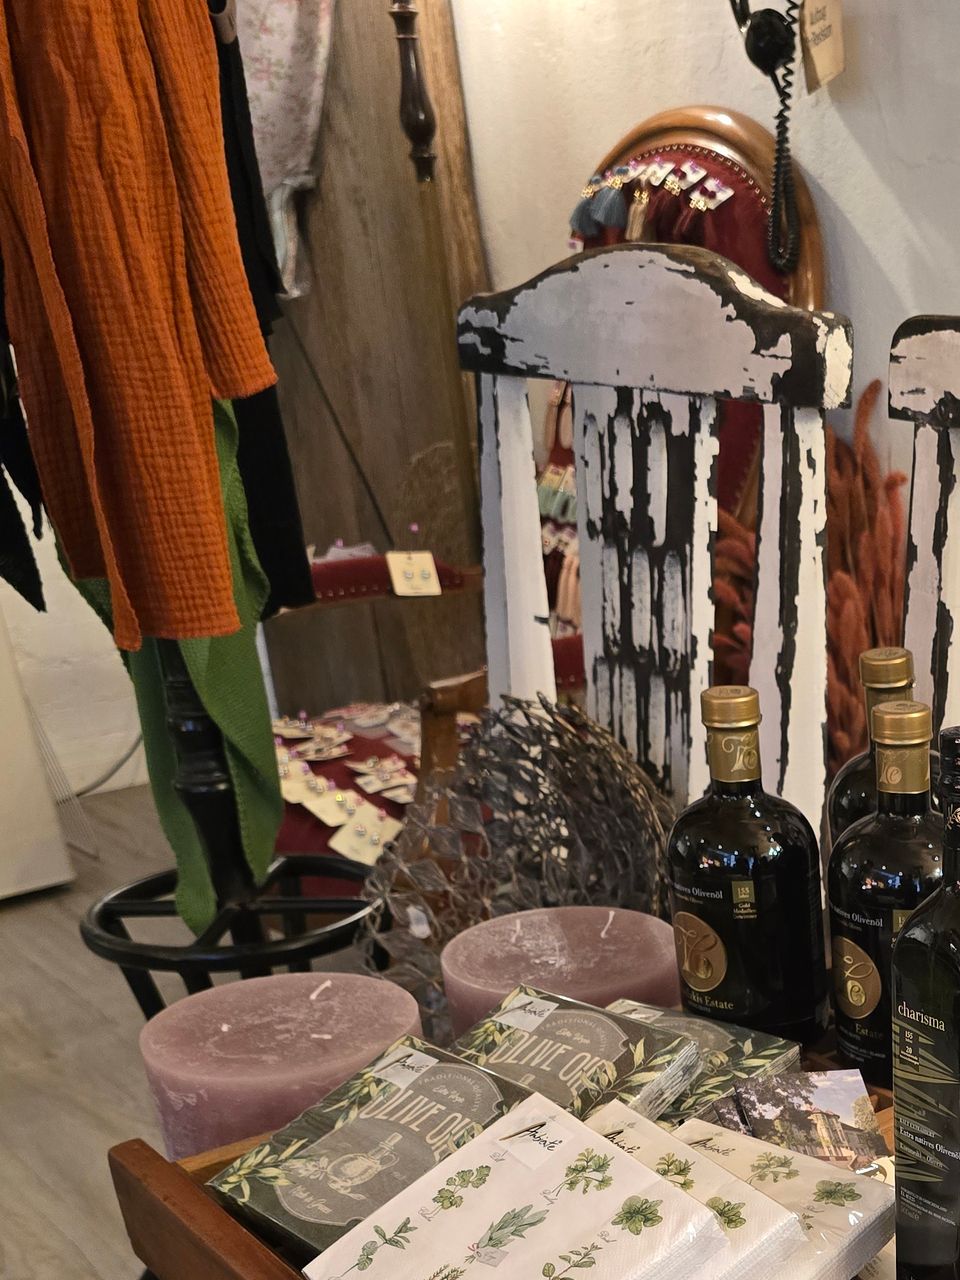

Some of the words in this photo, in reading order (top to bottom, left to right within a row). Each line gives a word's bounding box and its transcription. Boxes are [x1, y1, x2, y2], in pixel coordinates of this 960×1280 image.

[691, 886, 723, 899] Olivenöl
[738, 887, 750, 895] 155
[851, 912, 883, 927] Olivenöl
[704, 995, 734, 1010] Estate
[898, 1001, 945, 1031] charisma
[489, 1030, 573, 1072] OLIVE
[358, 1089, 447, 1133] OLIVE
[499, 1121, 562, 1152] Ambiente
[899, 1126, 914, 1140] Extra
[914, 1134, 934, 1149] natives
[935, 1142, 960, 1161] Olivenöl
